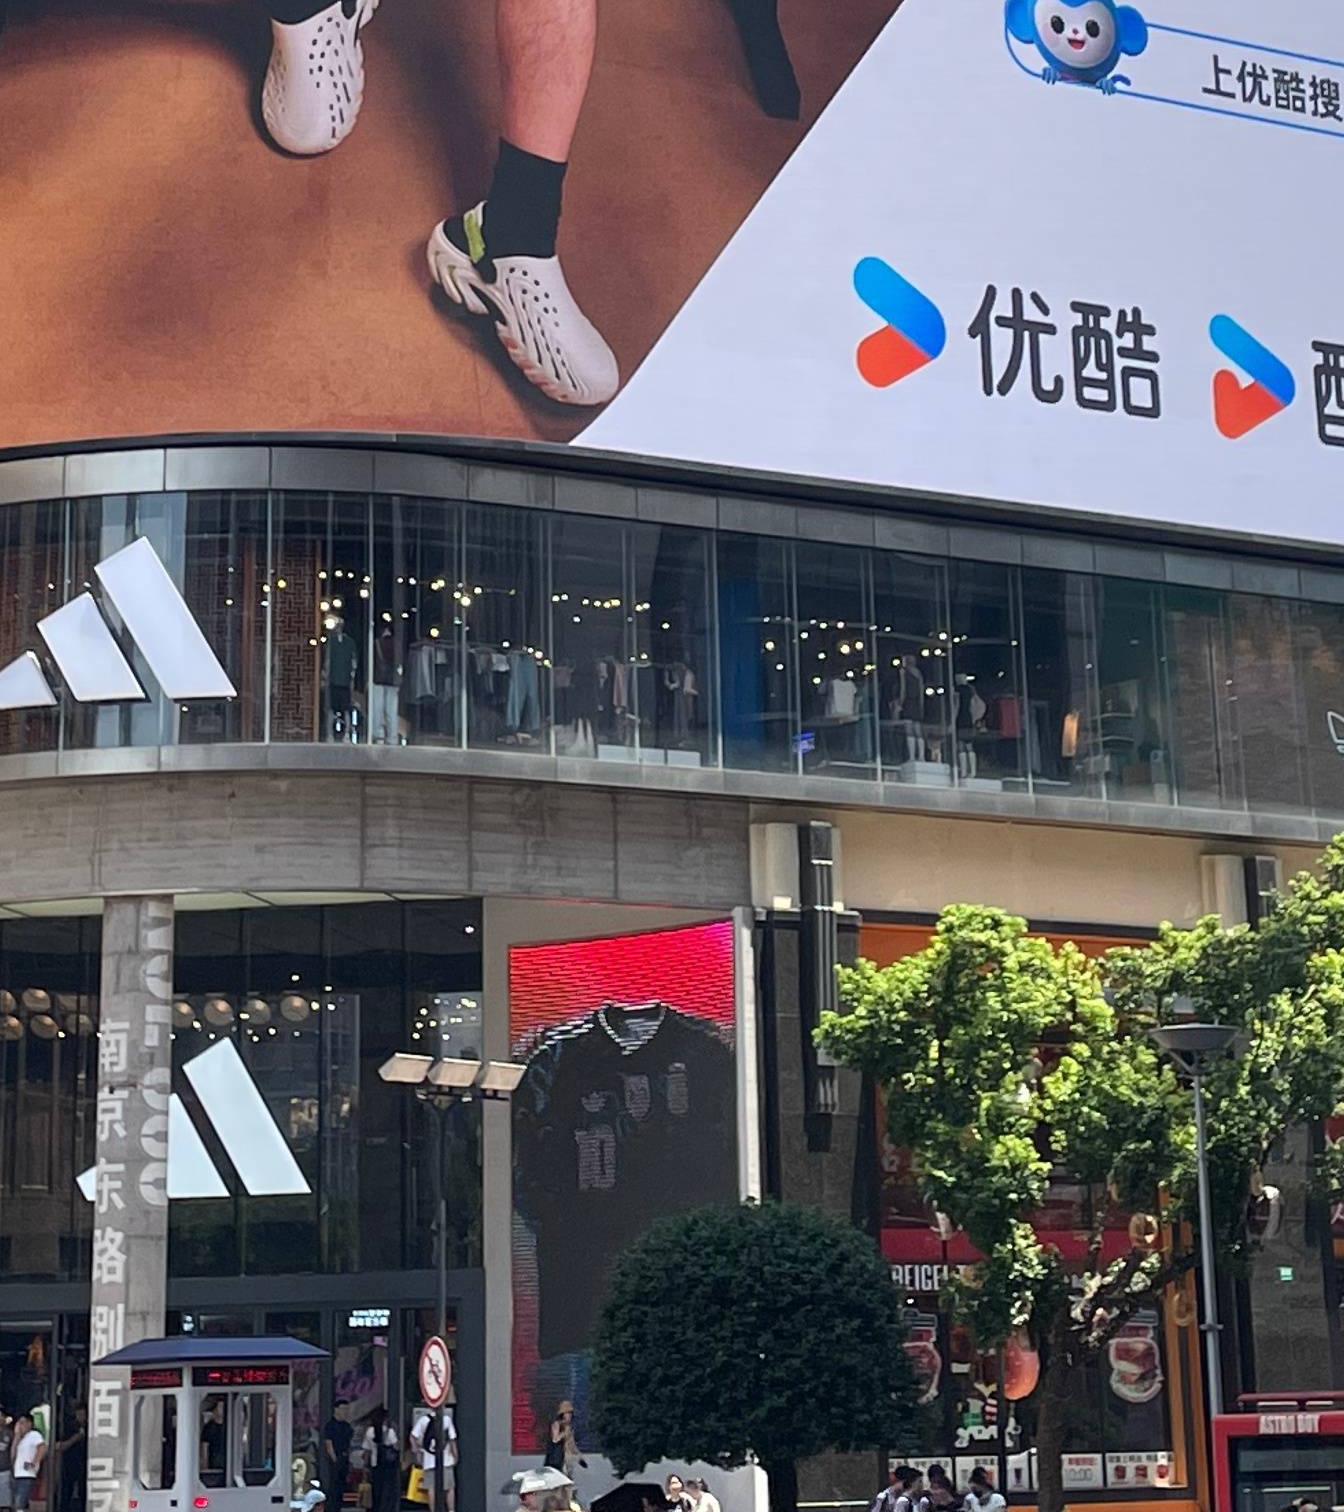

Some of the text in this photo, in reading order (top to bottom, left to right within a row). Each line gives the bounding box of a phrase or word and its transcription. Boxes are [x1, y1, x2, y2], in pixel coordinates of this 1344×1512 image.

[1202, 54, 1343, 122] 上优酷搜
[967, 284, 1161, 419] 优酷
